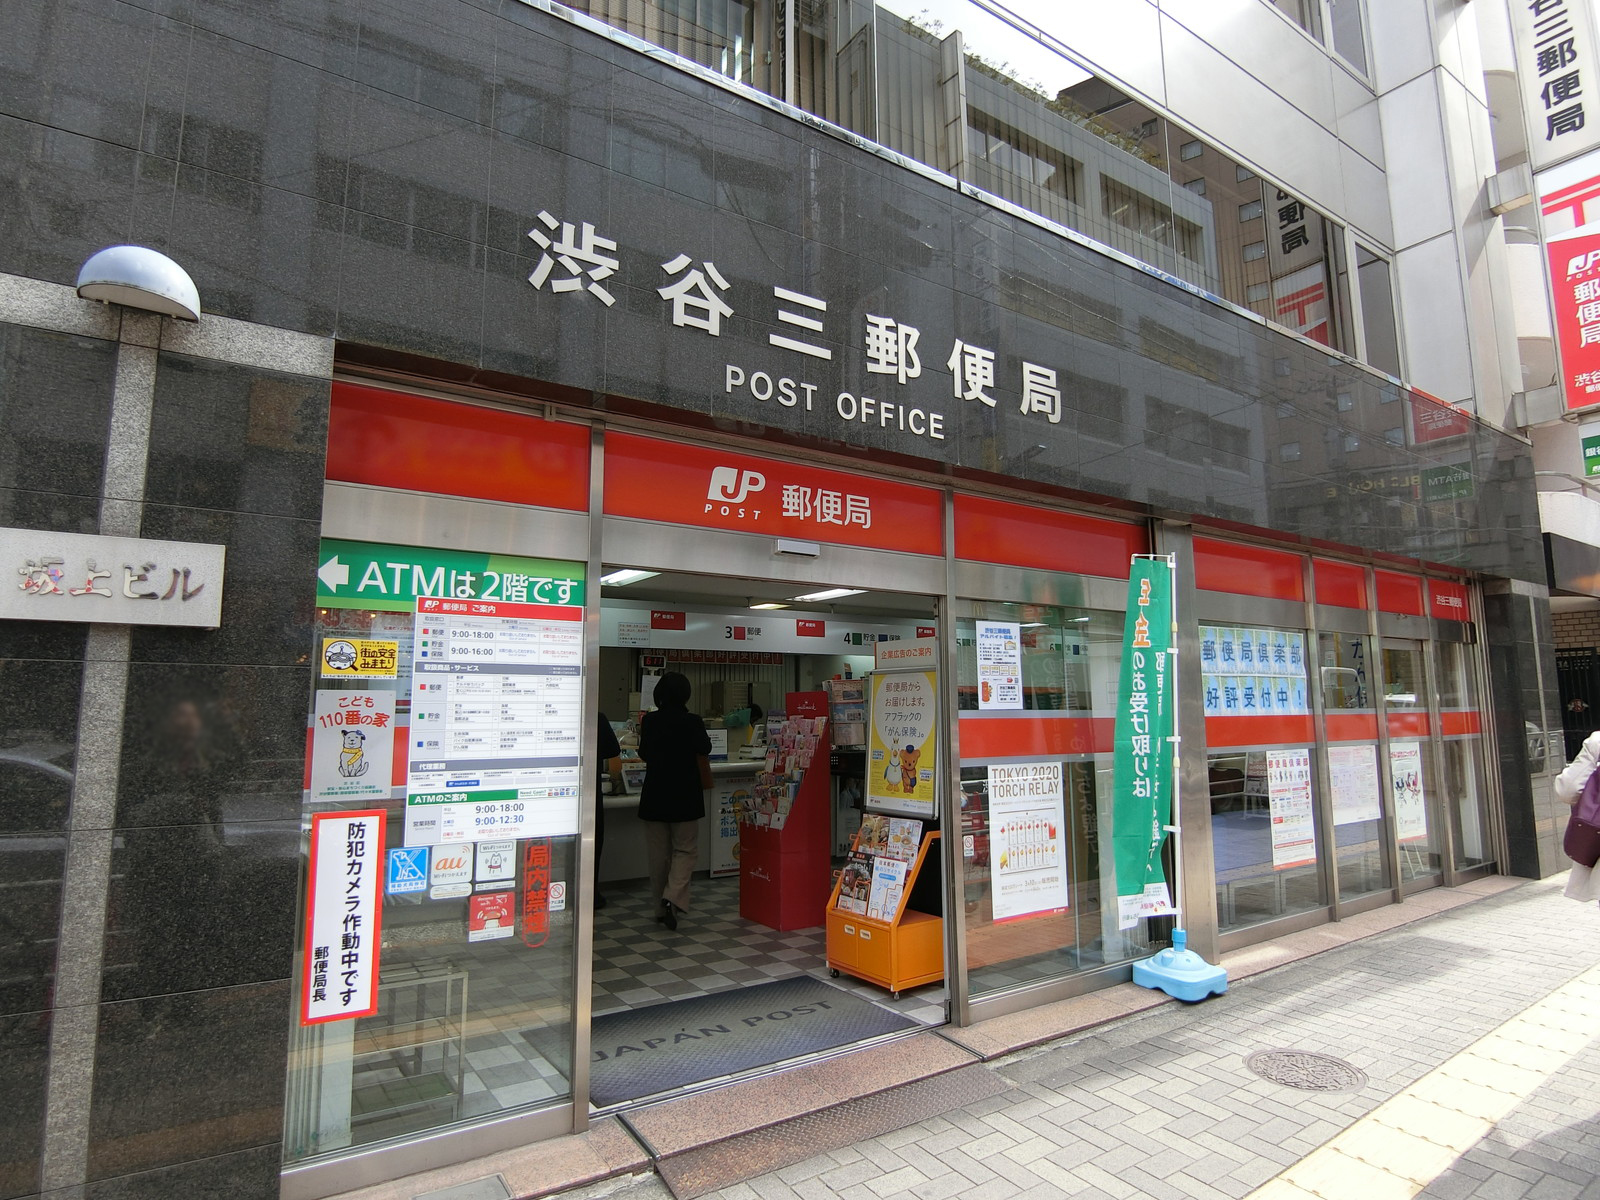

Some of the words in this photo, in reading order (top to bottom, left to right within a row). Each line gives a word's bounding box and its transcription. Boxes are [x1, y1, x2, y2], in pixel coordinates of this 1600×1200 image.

[1566, 267, 1600, 281] POS
[528, 210, 1062, 424] 渋谷三郵便局
[1574, 278, 1600, 348] 郵便局
[726, 364, 817, 410] POST
[837, 392, 944, 440] OFFICE
[704, 503, 761, 521] POST
[782, 484, 872, 529] 郵便局
[18, 557, 205, 601] 坂上ビル
[357, 561, 579, 604] ATMは2階です
[442, 602, 468, 612] 郵便局
[472, 604, 496, 614] ご案内
[451, 630, 494, 639] 9:00-18:00
[725, 626, 733, 639] 3
[747, 626, 761, 636] 郵便
[843, 632, 851, 644] 4
[863, 633, 876, 641] 貯金
[360, 647, 397, 658] 街の安全
[451, 647, 494, 656] 9:00-16:00
[881, 647, 932, 660] 企業広告のご案内
[1202, 639, 1301, 665] 郵便局倶楽部
[885, 681, 922, 693] 郵便局から
[338, 696, 375, 708] こども
[885, 697, 926, 708] お届けします。
[1206, 686, 1302, 709] 好評受付中！
[319, 709, 391, 729] 110番の家
[884, 711, 922, 722] アフラックの
[883, 726, 925, 739] 「がん保険」。
[992, 767, 1028, 783] TOKYO
[1032, 765, 1059, 781] 2020
[992, 783, 1026, 798] TORCH
[1028, 781, 1059, 796] RELAY
[414, 793, 468, 803] ATMのご案内
[475, 803, 525, 814] 9:00-18:00
[413, 819, 436, 827] 営業時間
[475, 814, 524, 826] 9:00-12:30
[435, 857, 468, 870] au
[339, 821, 367, 1007] 防犯カメラ作動中です
[312, 945, 330, 1003] 郵便局長
[591, 1023, 732, 1063] JAPAN
[742, 999, 834, 1027] POST
